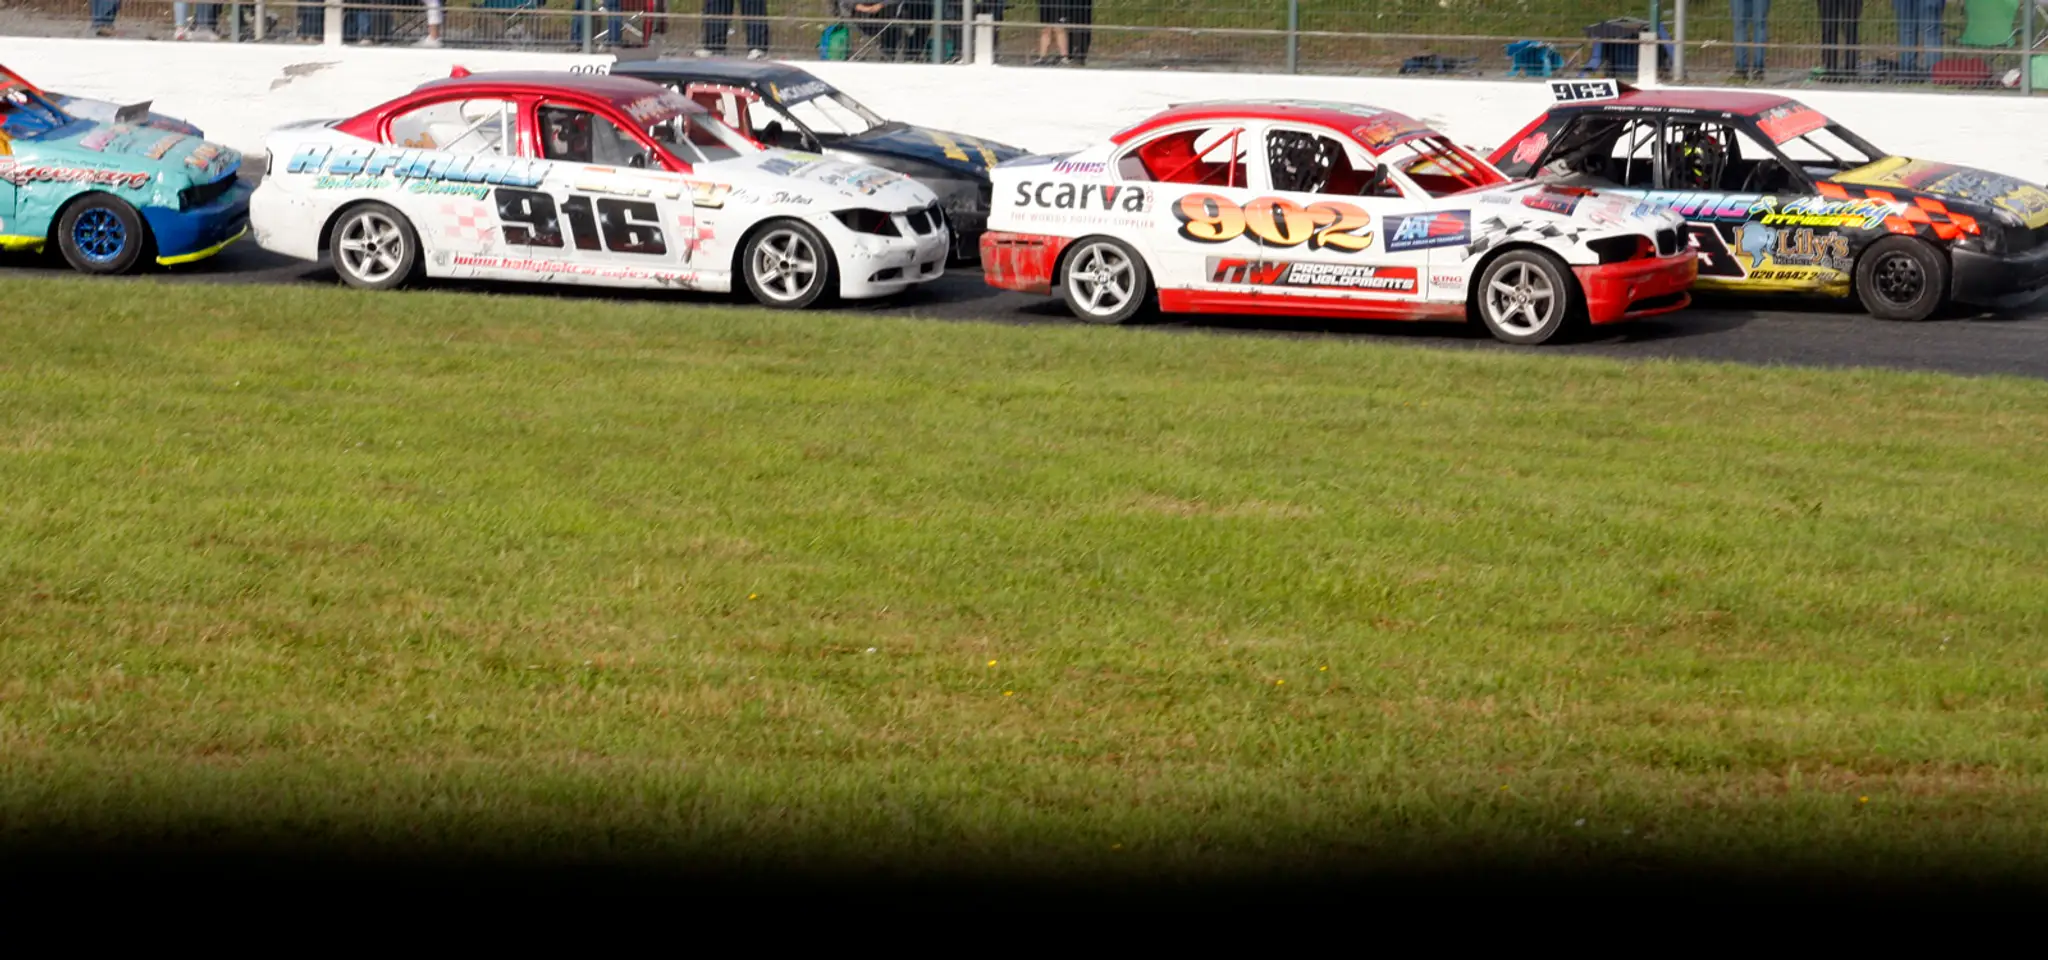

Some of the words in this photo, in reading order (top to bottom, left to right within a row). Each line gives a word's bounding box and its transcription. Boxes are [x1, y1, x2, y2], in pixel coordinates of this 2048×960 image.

[1552, 82, 1614, 101] 963
[1014, 180, 1145, 213] scarva
[494, 188, 667, 255] 916
[1171, 191, 1373, 253] 902
[1777, 227, 1850, 261] Lily's
